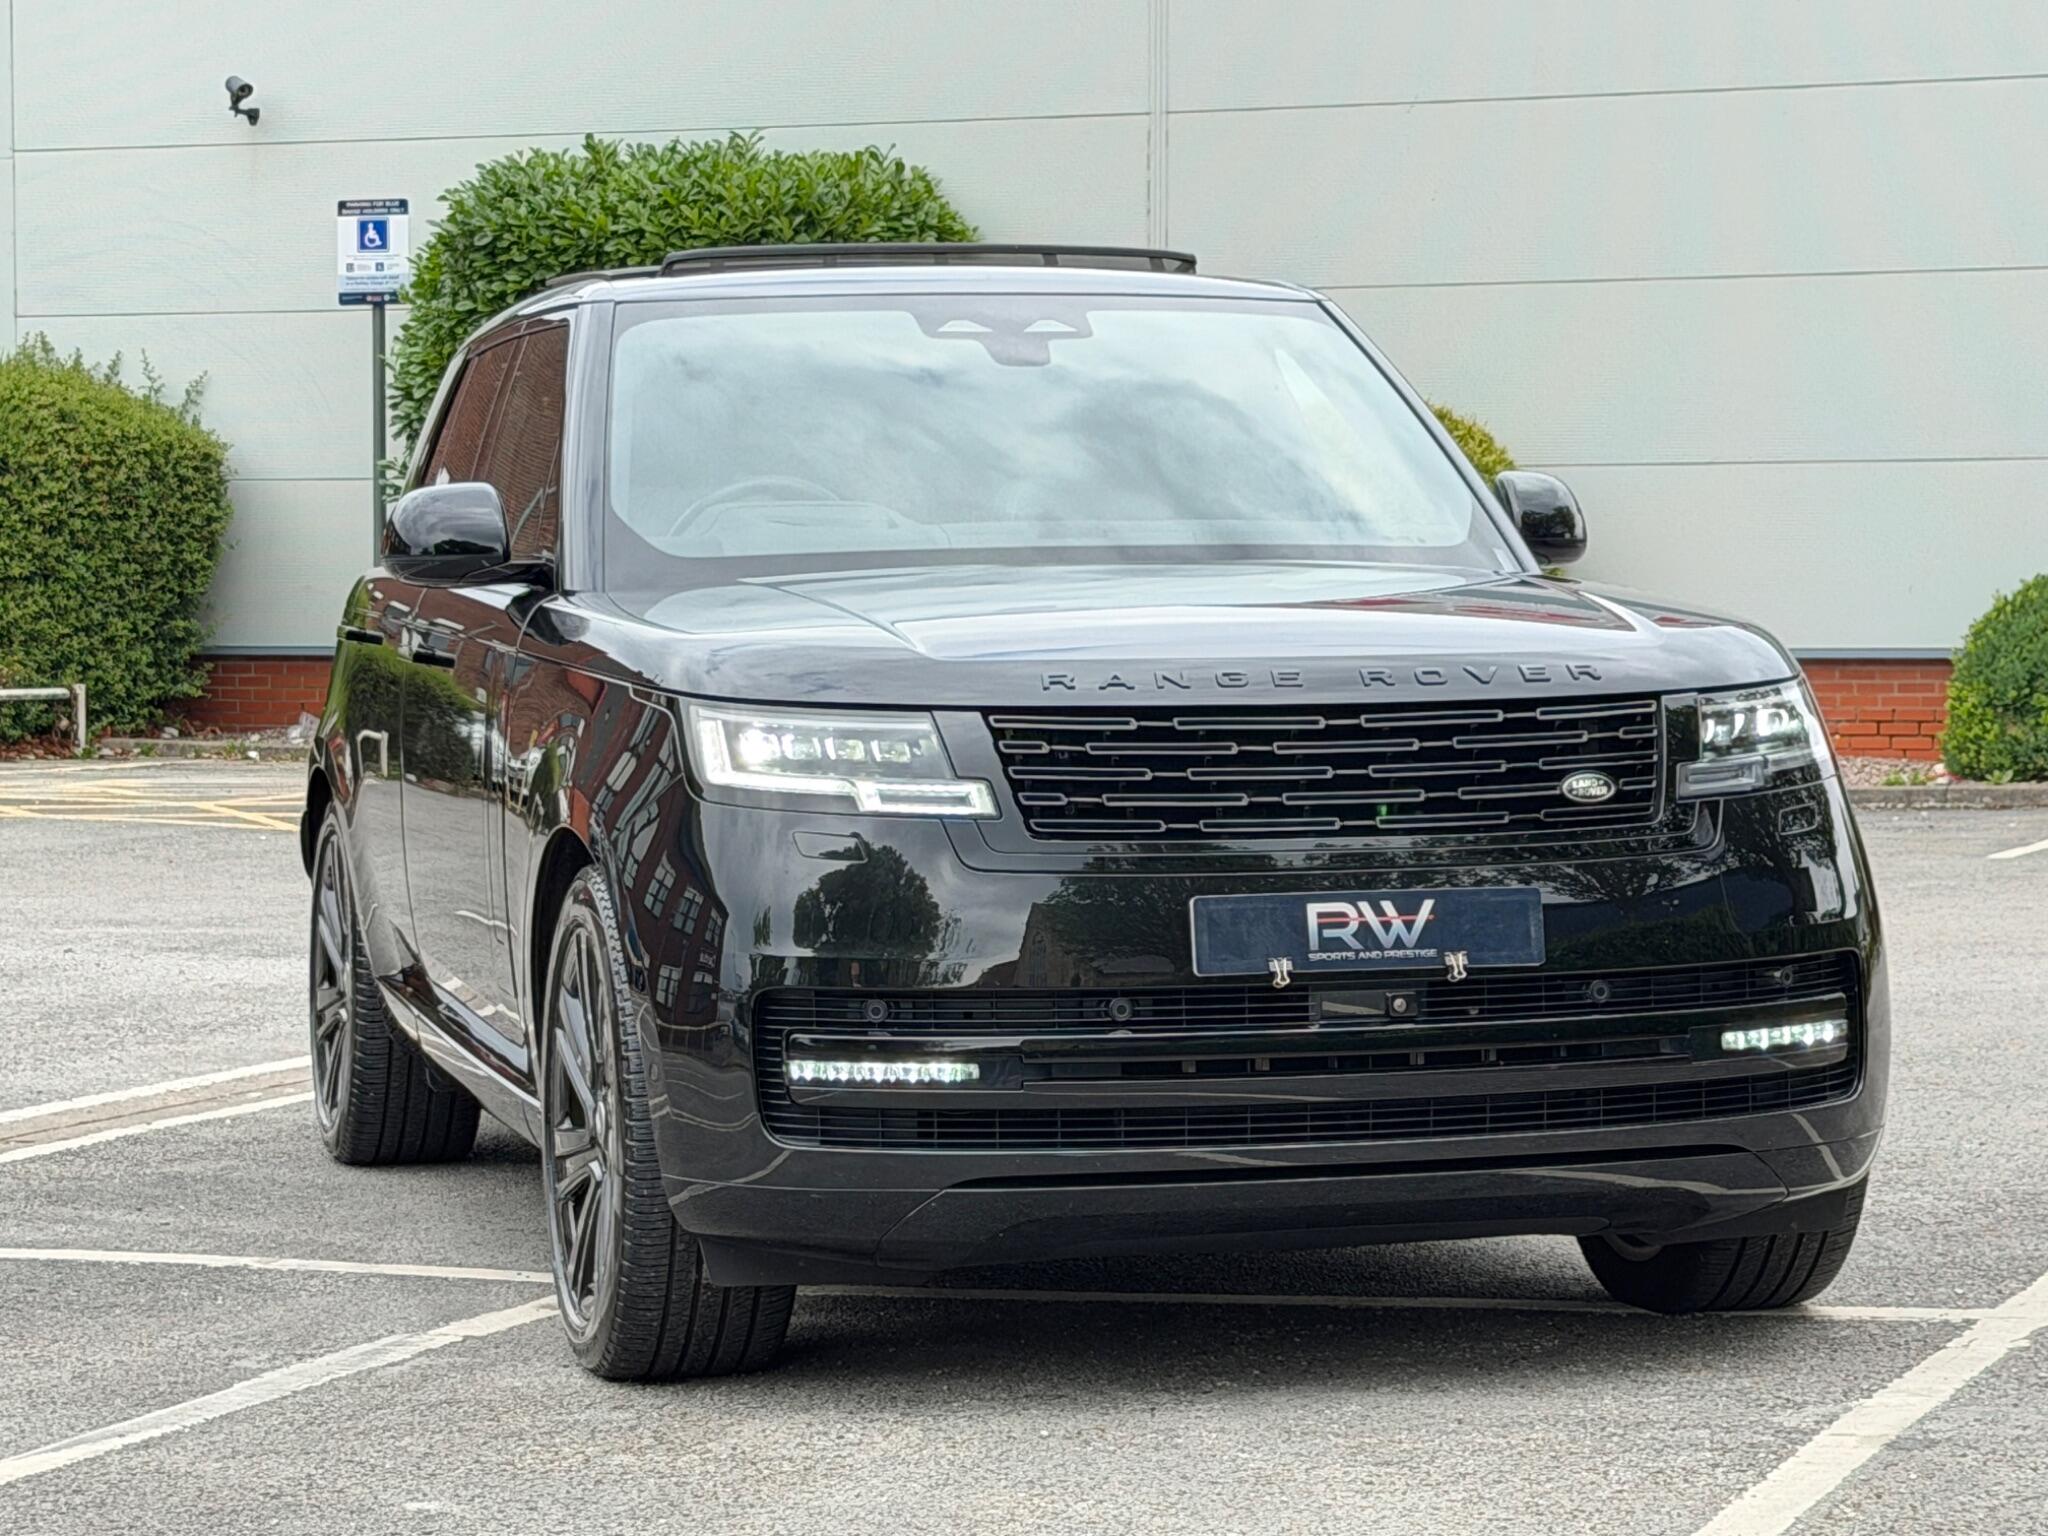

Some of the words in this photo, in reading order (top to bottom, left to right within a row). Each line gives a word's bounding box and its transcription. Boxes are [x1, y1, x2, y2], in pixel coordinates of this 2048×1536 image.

[1039, 671, 1304, 691] RANGE
[1359, 663, 1604, 688] ROVER
[1572, 778, 1598, 788] LAND
[1306, 899, 1436, 950] RW
[1308, 952, 1356, 961] SPORTS
[1358, 950, 1382, 960] AND
[1384, 948, 1438, 959] PRESTIGE
